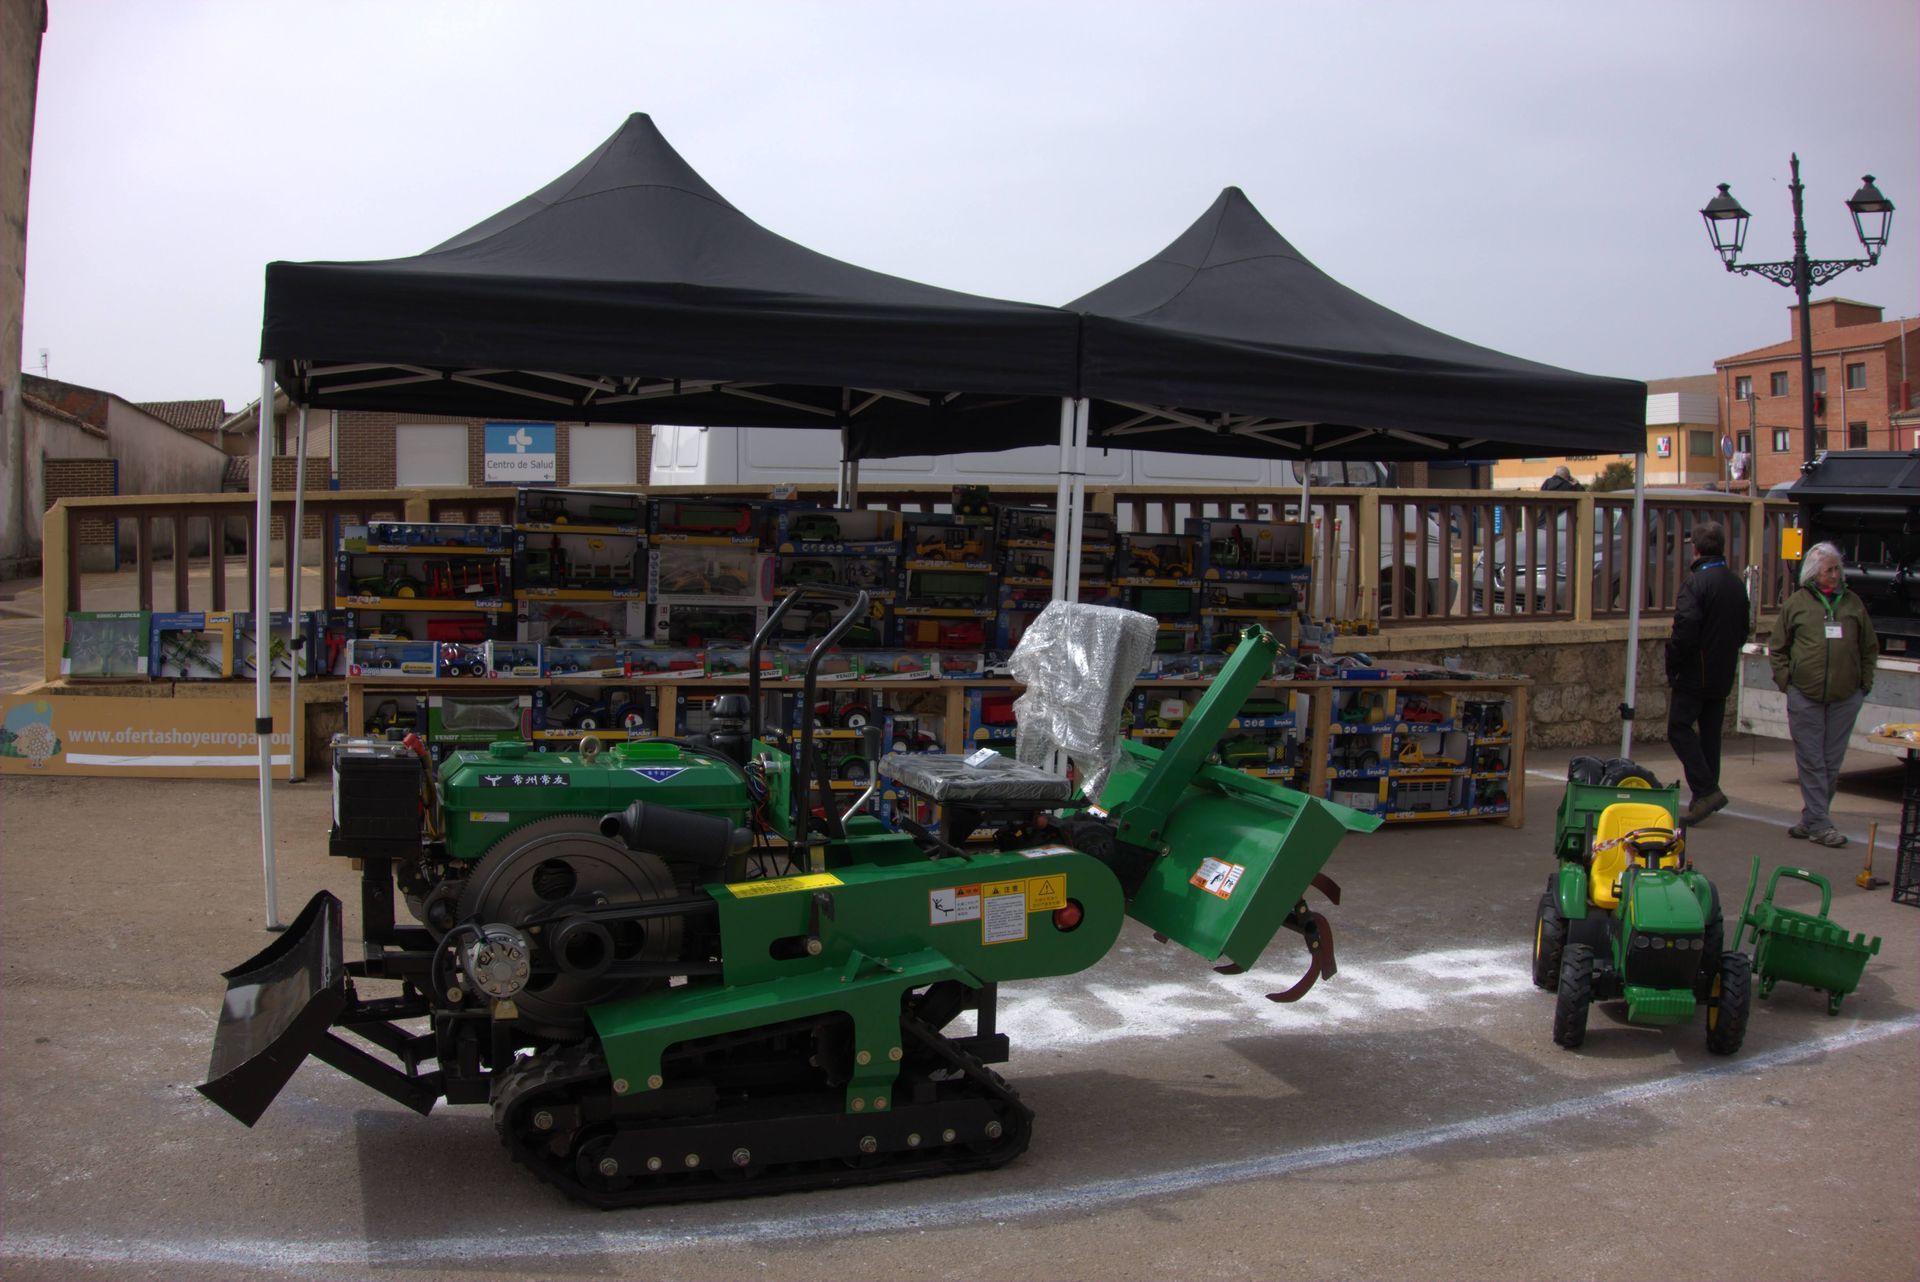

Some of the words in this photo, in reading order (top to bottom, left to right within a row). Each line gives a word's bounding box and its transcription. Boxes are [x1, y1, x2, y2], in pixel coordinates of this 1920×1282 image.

[487, 460, 515, 469] Centro
[517, 460, 527, 469] de
[531, 460, 554, 469] Salud
[475, 600, 503, 608] bruder
[836, 671, 856, 679] FENDT
[68, 728, 291, 748] www.ofertashoyeuropaom
